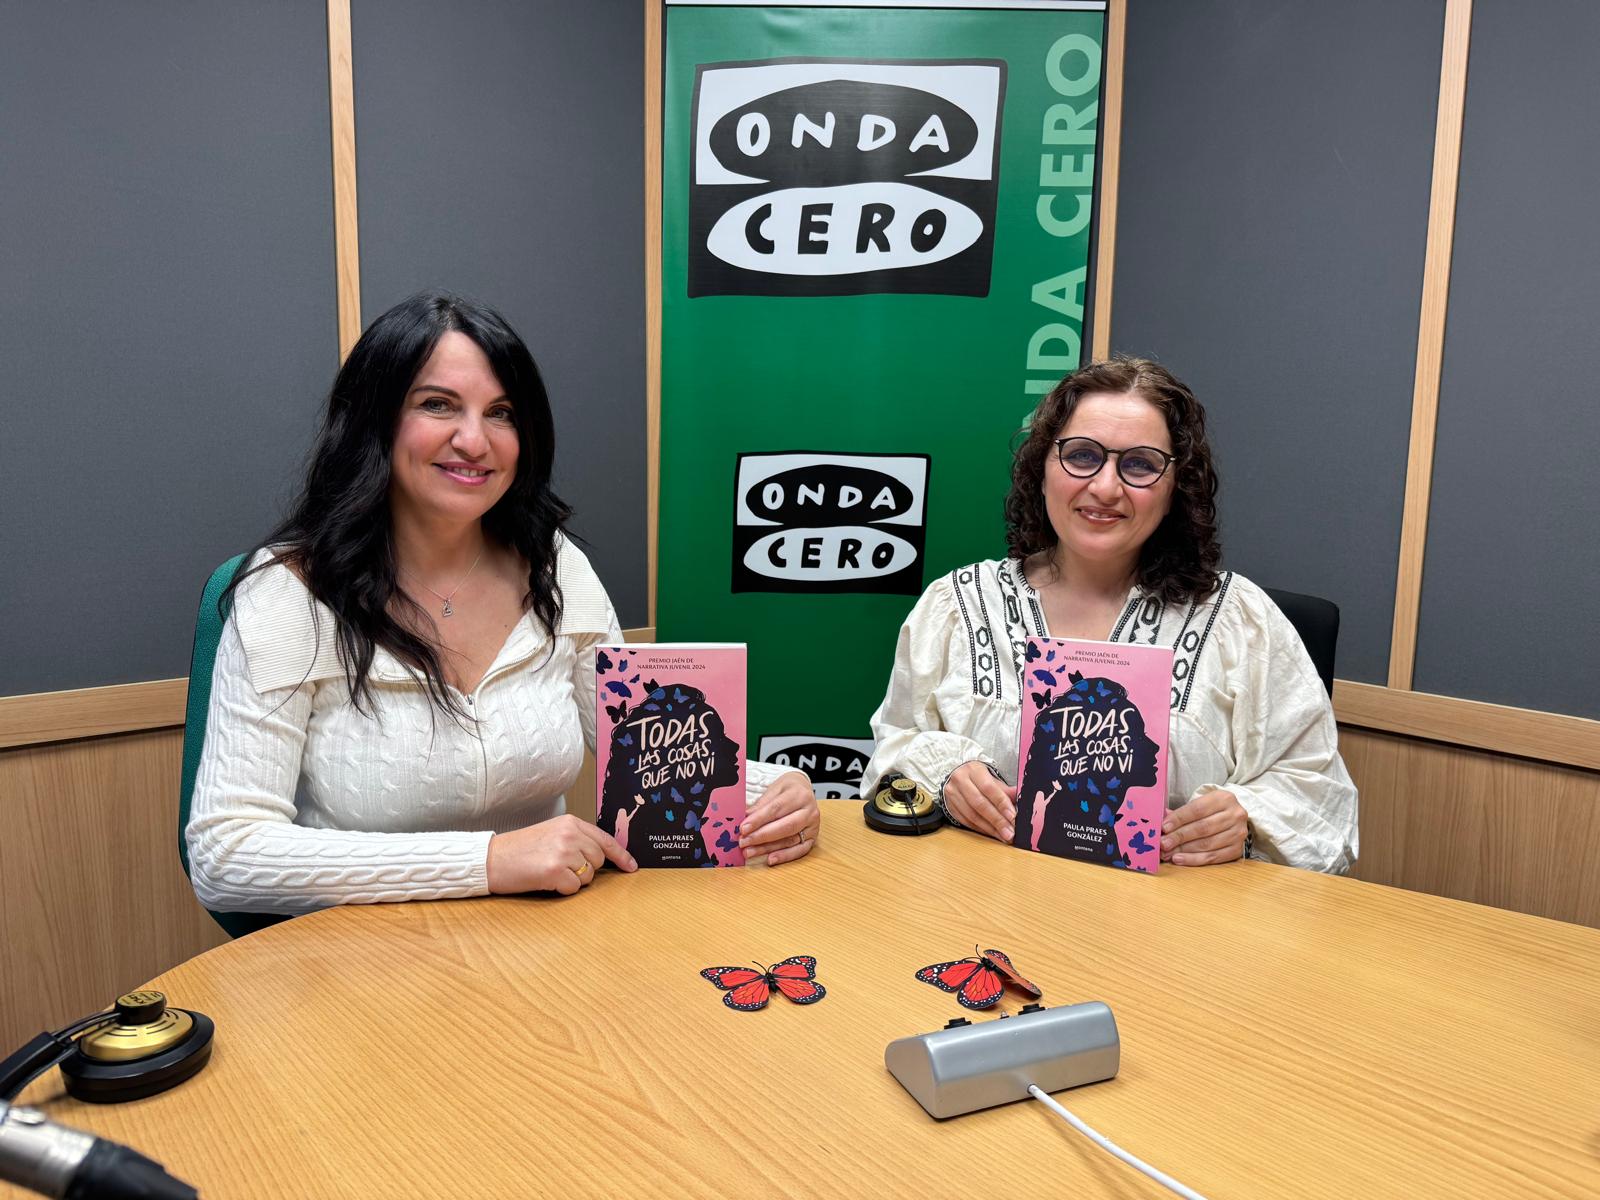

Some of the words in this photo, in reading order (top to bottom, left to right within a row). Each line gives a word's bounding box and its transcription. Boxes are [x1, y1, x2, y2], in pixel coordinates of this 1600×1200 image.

[736, 111, 950, 157] ONDA
[1036, 33, 1102, 237] CERO
[745, 202, 948, 255] CERO
[762, 482, 897, 511] ONDA
[767, 536, 895, 569] CERO
[1063, 655, 1094, 663] NARRATIVA
[626, 711, 714, 751] TODAS
[1049, 706, 1135, 739] TODAS
[634, 749, 661, 774] LAS
[667, 739, 712, 764] COSAS
[1053, 739, 1080, 760] LAS
[1086, 735, 1131, 755] COSAS
[641, 765, 671, 789] QUE
[675, 761, 696, 779] NO
[775, 753, 863, 773] ONDA
[1060, 755, 1088, 776] QUE
[1092, 755, 1114, 773] NO
[1063, 822, 1085, 832] PAULA
[1085, 826, 1107, 836] PRAES
[1066, 830, 1103, 843] GONZÁLEZ
[653, 841, 690, 849] GONZÁLEZ
